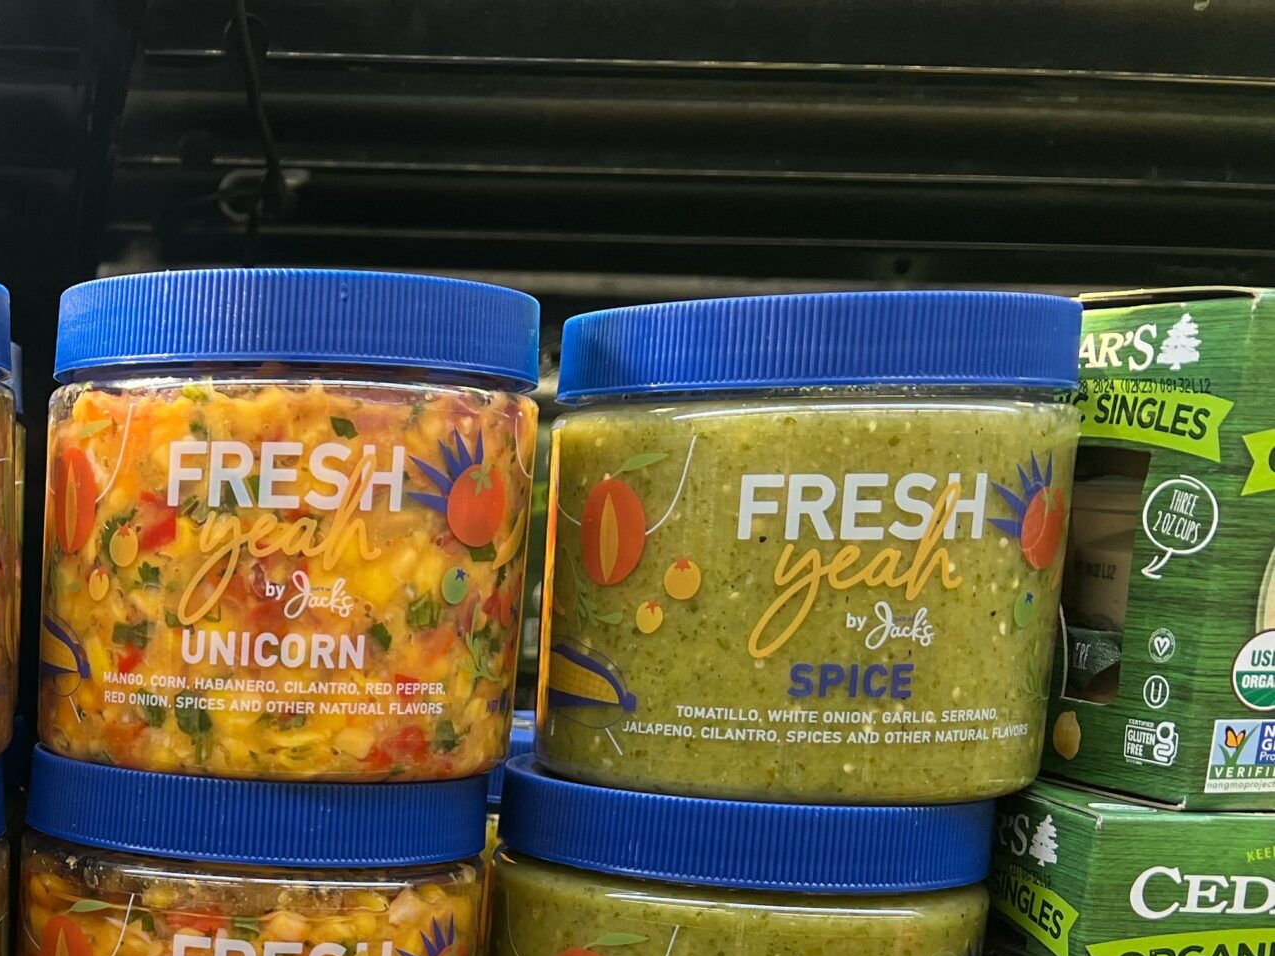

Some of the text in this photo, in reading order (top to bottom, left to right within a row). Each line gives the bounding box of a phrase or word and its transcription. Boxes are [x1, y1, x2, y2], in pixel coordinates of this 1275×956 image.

[1094, 393, 1211, 440] SINGLES
[167, 440, 405, 512] FRESH
[737, 473, 988, 541] FRESH
[178, 454, 381, 626] yeah
[748, 482, 962, 658] yeah
[265, 570, 353, 619] by Jack's
[846, 600, 934, 650] by Jack's
[181, 629, 365, 669] UNICORN
[104, 691, 125, 705] RED
[176, 696, 224, 710] SPICES
[230, 699, 262, 712] AND
[266, 700, 315, 714] OTHER
[319, 701, 385, 715] NATURAL
[389, 702, 443, 715] FLAVORS
[787, 663, 915, 698] SPICE
[768, 709, 818, 723] WHITE
[1127, 729, 1155, 745] GLUTEN
[1126, 742, 1143, 756] FREE
